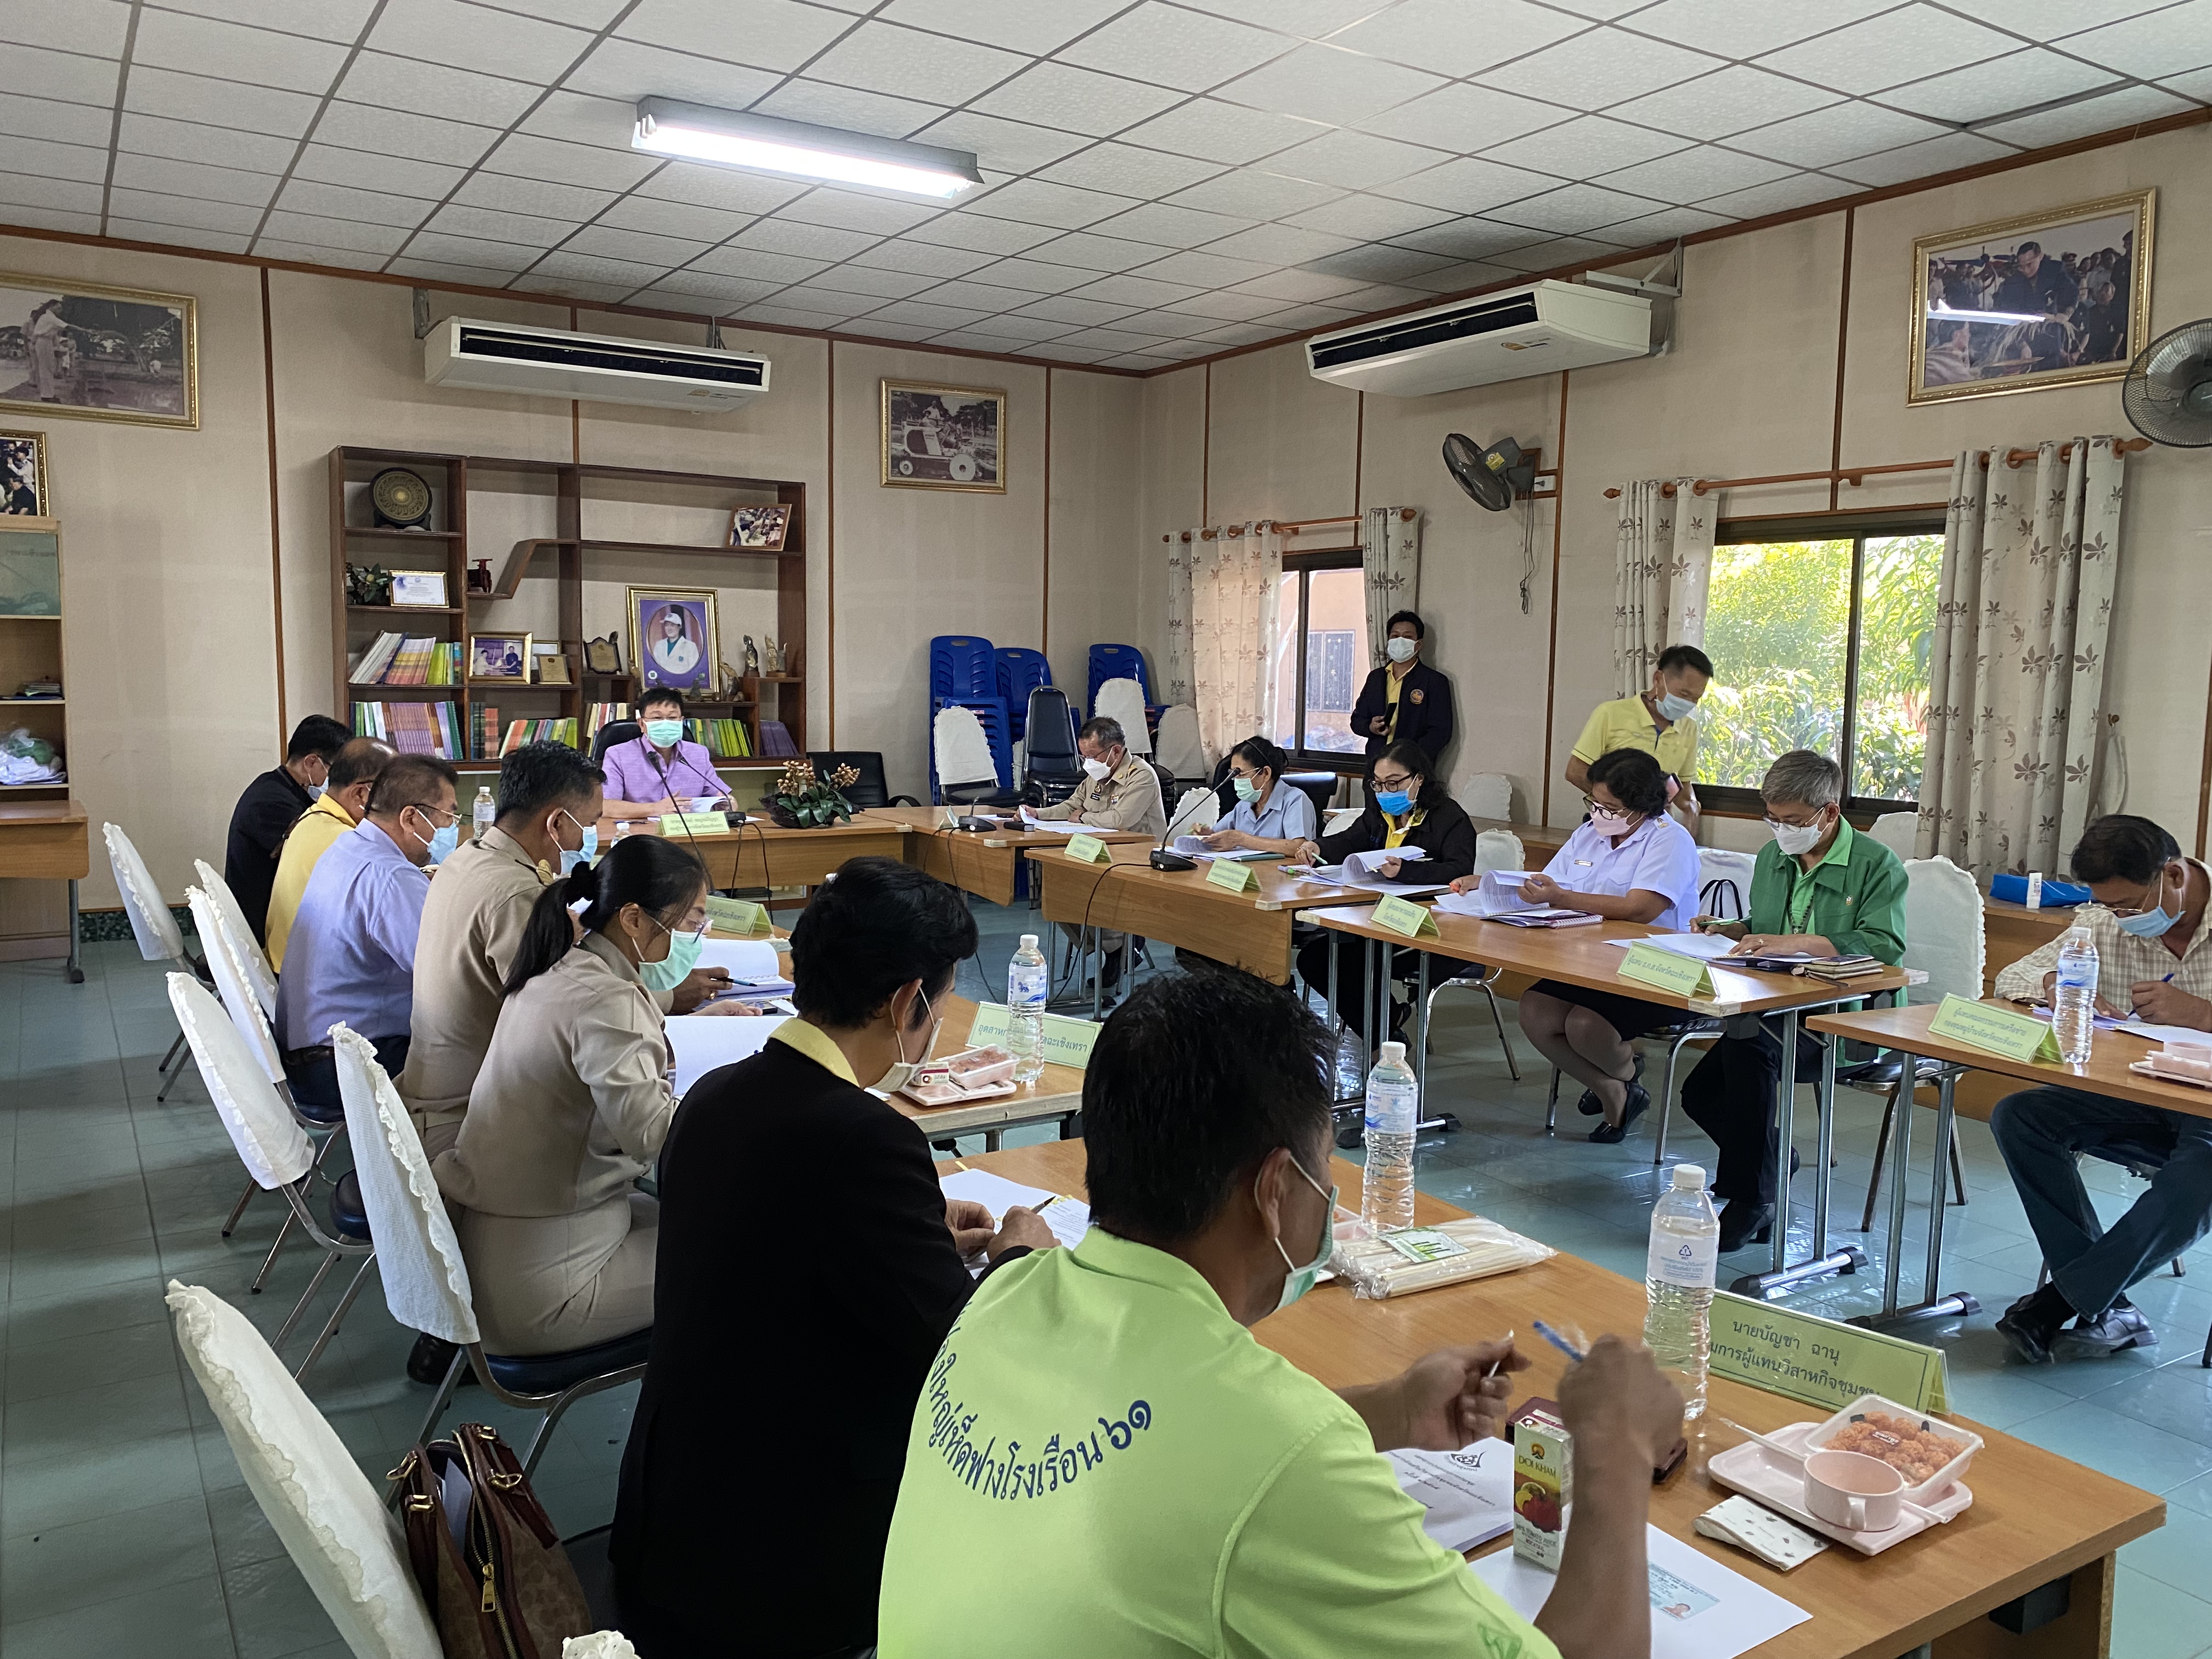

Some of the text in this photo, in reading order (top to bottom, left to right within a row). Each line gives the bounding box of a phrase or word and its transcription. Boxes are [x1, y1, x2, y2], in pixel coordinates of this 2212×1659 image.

[1733, 1321, 1840, 1367] นายบัญชา ฉานุ
[1519, 1455, 1533, 1468] DOI
